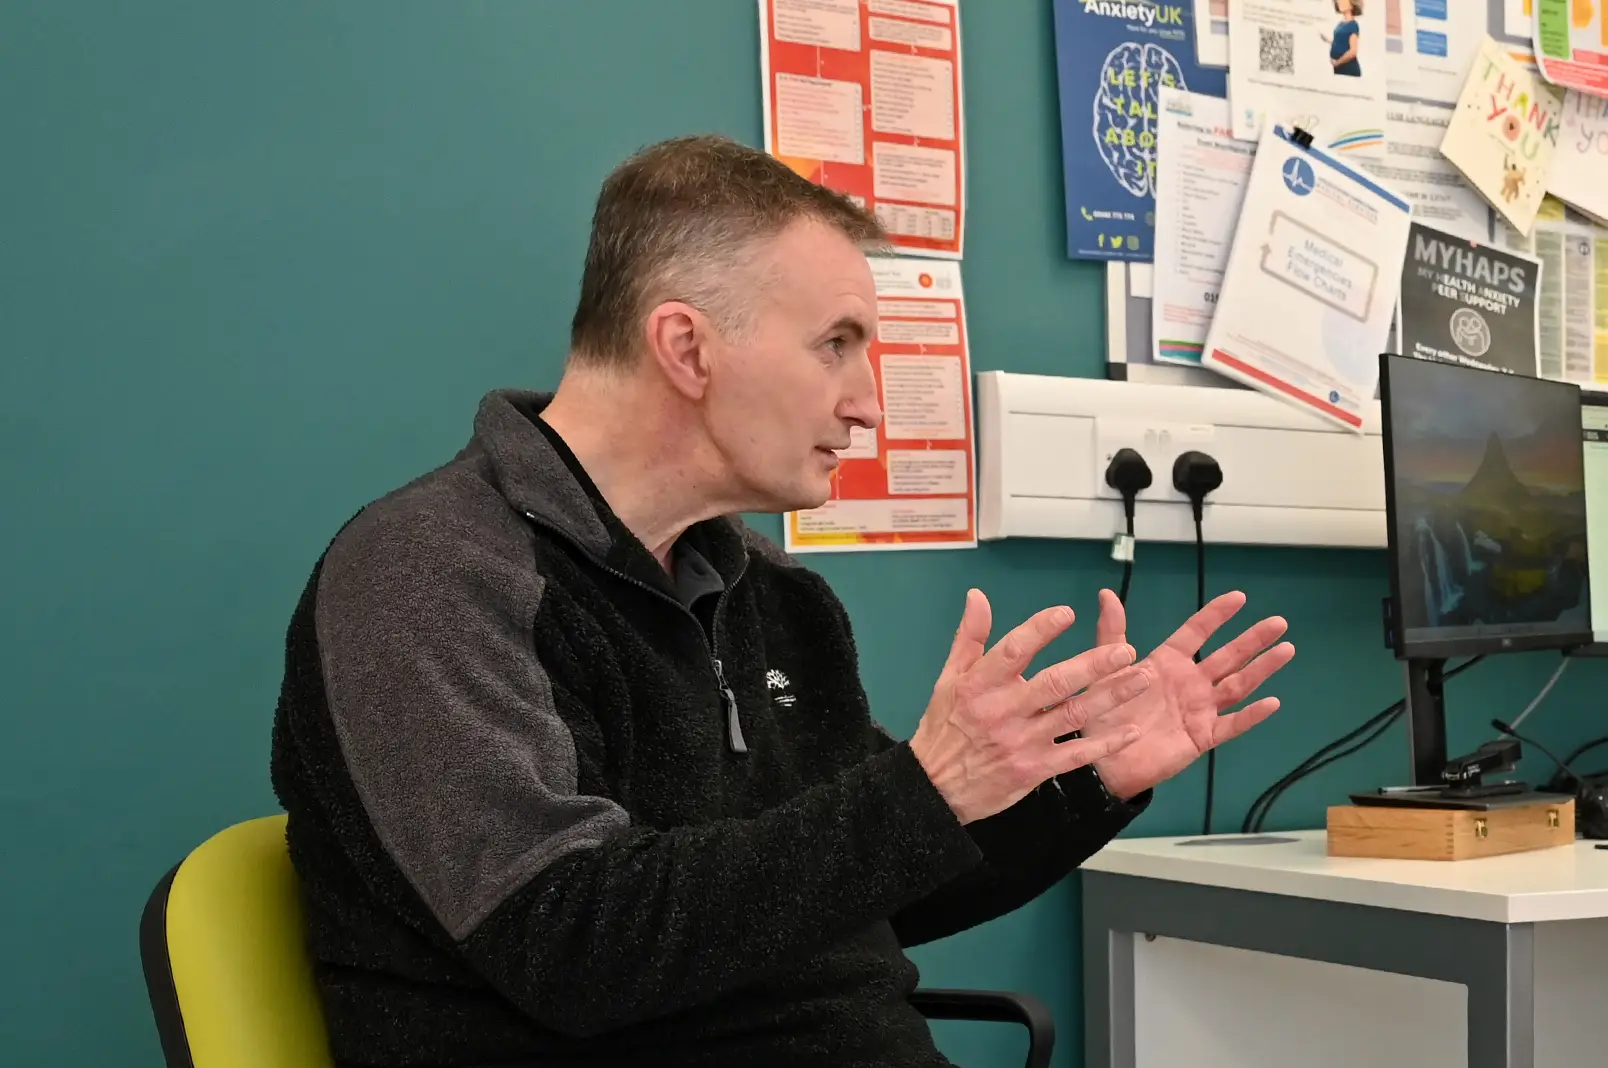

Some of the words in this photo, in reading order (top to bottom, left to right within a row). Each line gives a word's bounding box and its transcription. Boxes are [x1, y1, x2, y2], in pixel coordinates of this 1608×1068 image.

[1083, 0, 1183, 27] AnxietyUK
[1108, 67, 1177, 89] LET'S
[1115, 97, 1158, 119] TAL
[1483, 53, 1560, 148] THANK
[1487, 93, 1541, 160] YOU
[1304, 238, 1343, 268] Medical
[1413, 233, 1526, 293] MYHAPS
[1431, 282, 1458, 301] PEER
[1459, 291, 1508, 316] SUPPORT
[1435, 271, 1477, 294] HEALTH
[1478, 284, 1521, 309] ANXIETY
